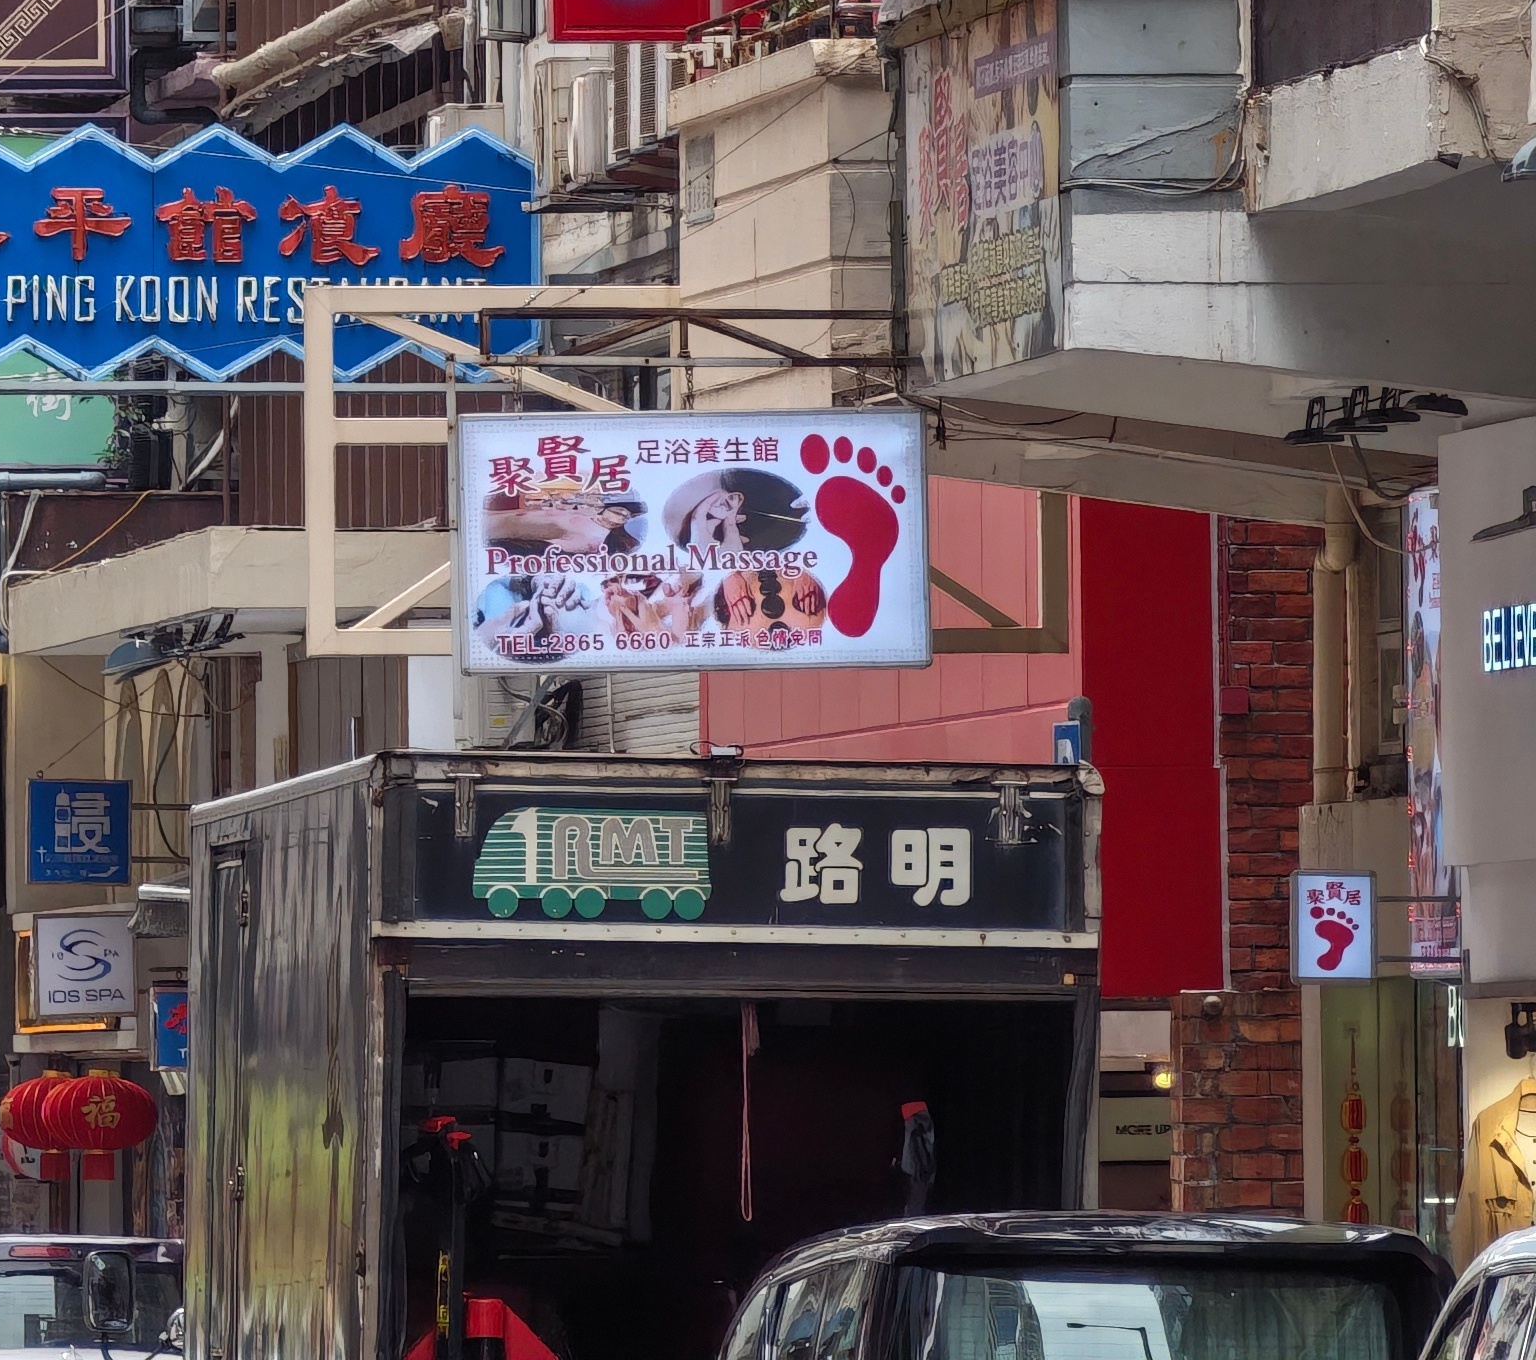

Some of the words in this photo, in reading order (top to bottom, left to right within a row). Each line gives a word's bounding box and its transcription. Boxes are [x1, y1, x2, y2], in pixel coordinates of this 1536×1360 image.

[6, 275, 96, 322] PING
[115, 275, 219, 323] KOON
[488, 435, 632, 494] 聚賢居
[635, 436, 780, 465] 足浴養生館
[485, 544, 677, 575] Professional
[688, 543, 819, 577] Massage
[615, 632, 671, 651] 6660
[779, 823, 971, 907] 路明
[1306, 881, 1362, 906] 聚賢居
[48, 990, 81, 1004] IOS
[85, 988, 126, 1003] SPA
[80, 1094, 121, 1130] 福
